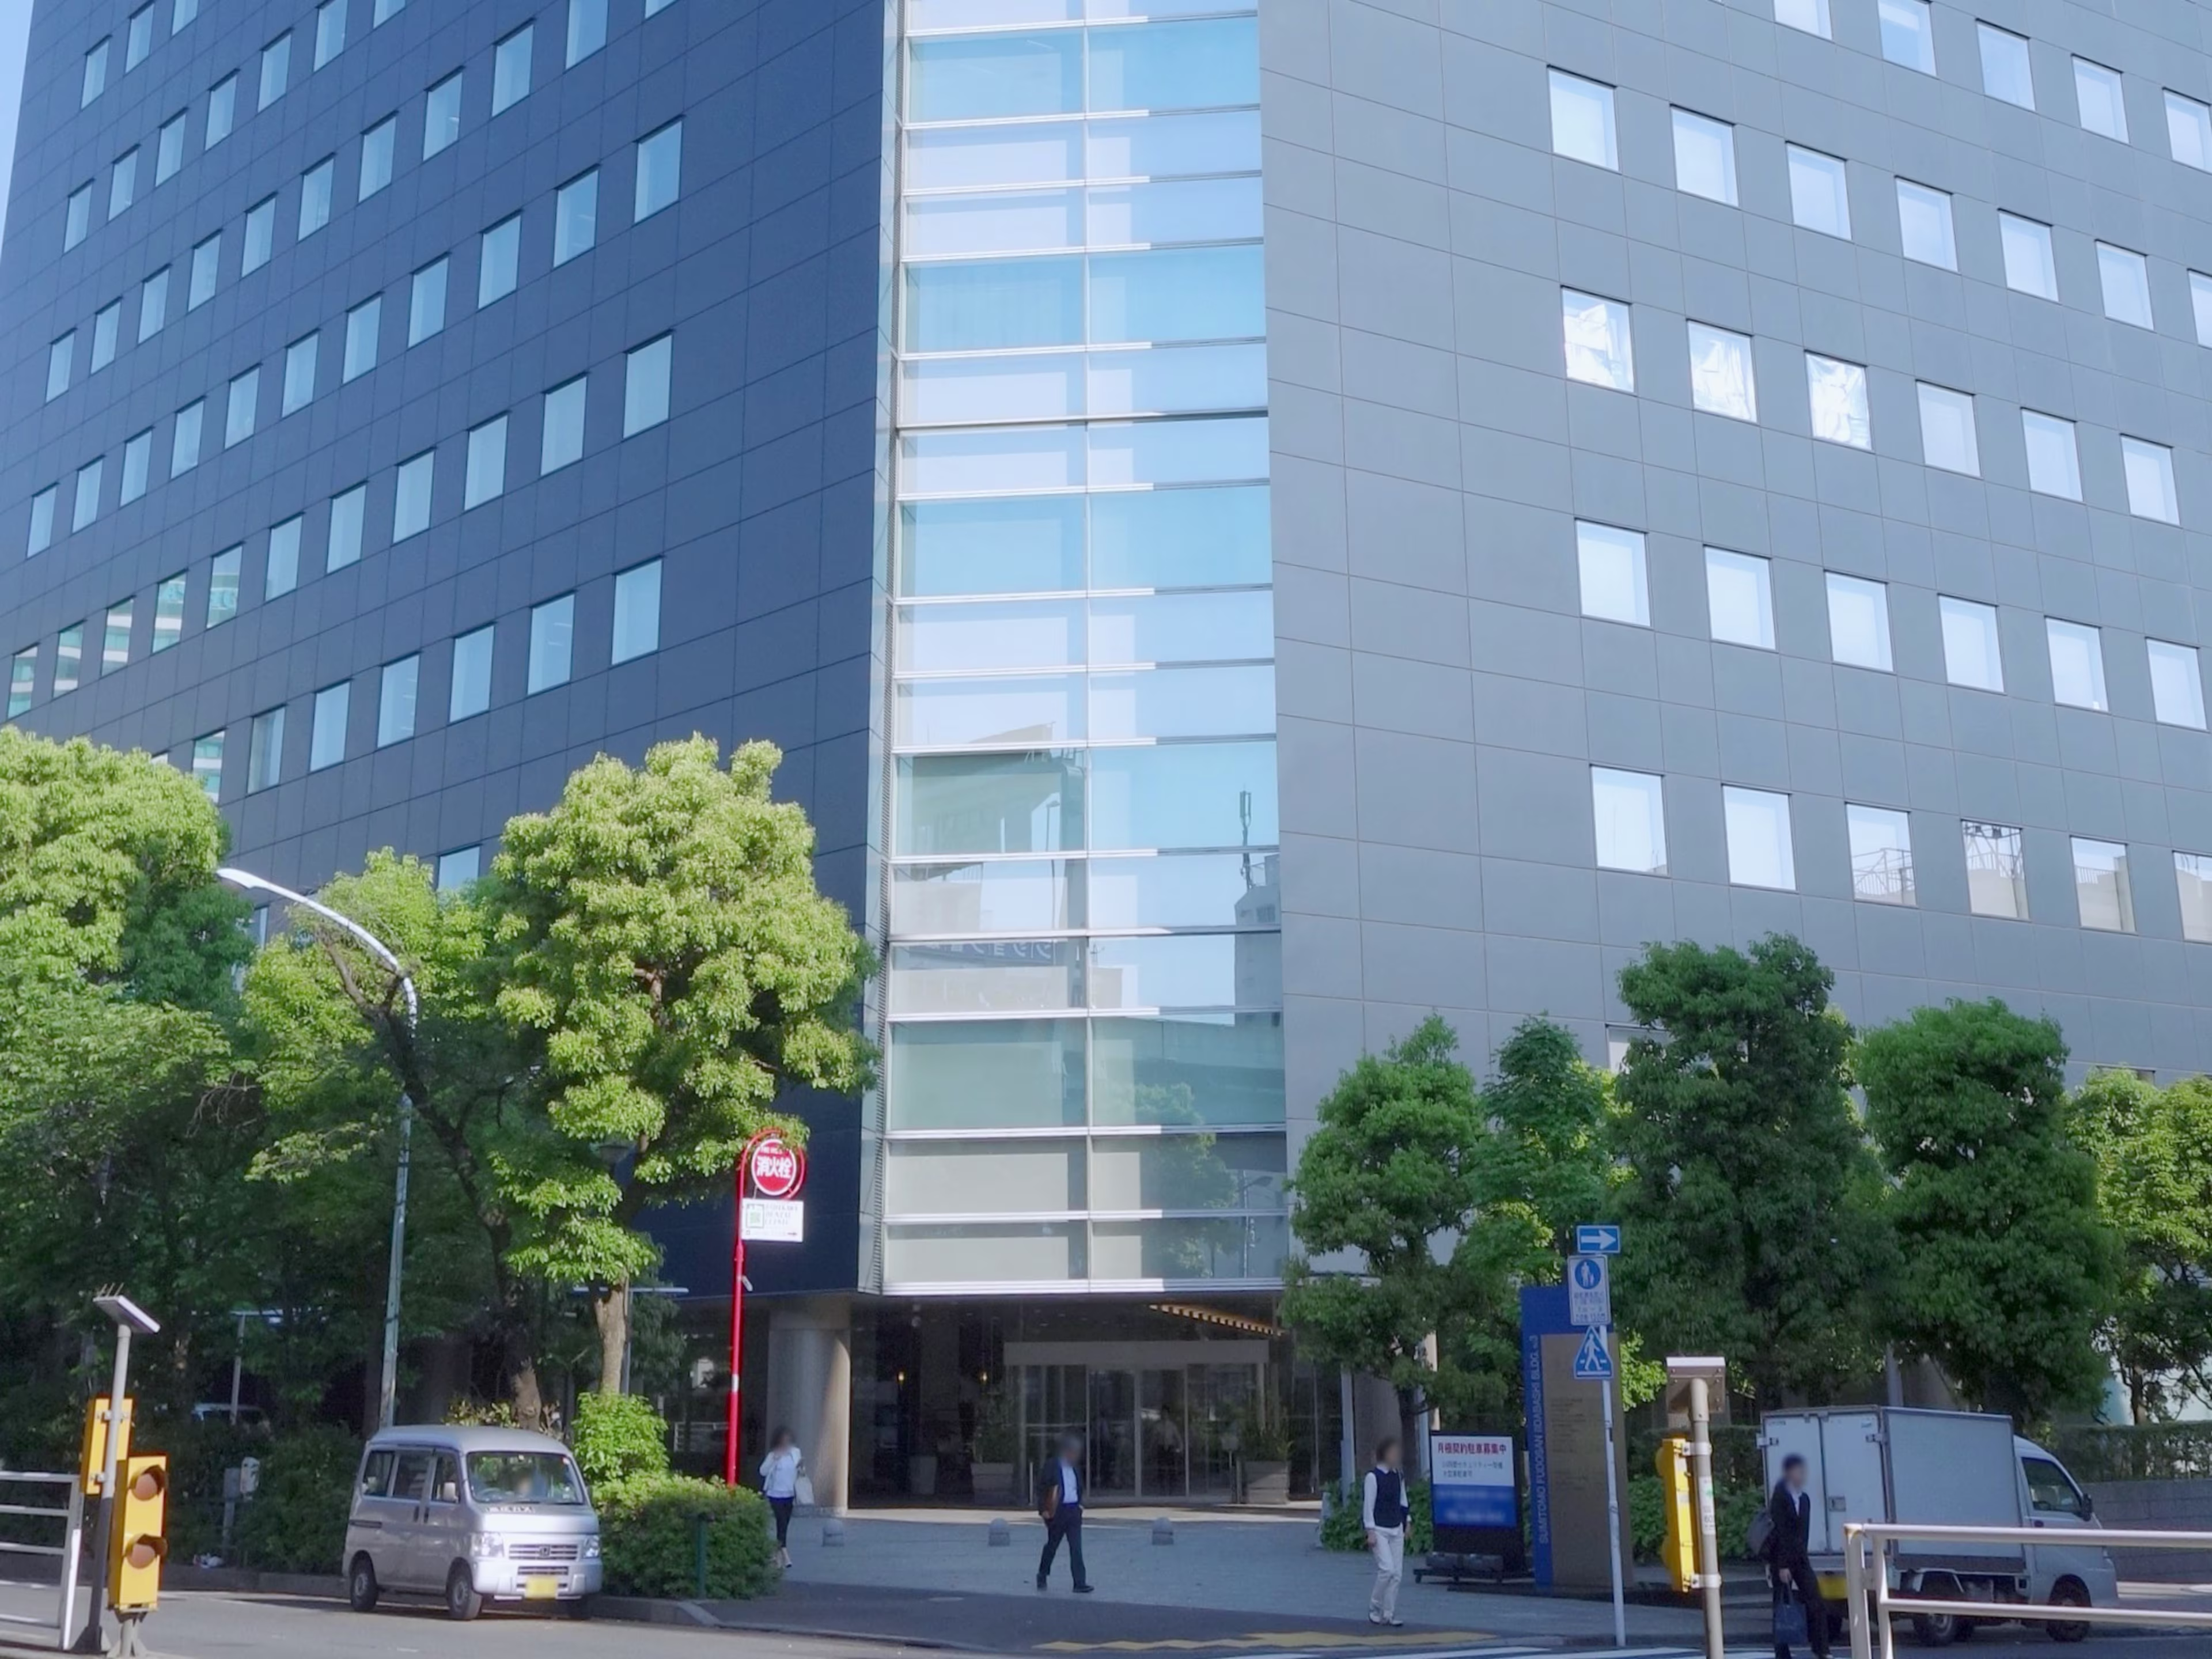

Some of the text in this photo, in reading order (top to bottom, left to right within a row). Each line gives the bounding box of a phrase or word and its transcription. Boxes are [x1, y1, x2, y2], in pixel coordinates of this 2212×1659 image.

[756, 1156, 793, 1178] 消火栓
[1534, 1435, 1546, 1484] FUDOSAN
[1537, 1487, 1549, 1544] SUMITOMO
